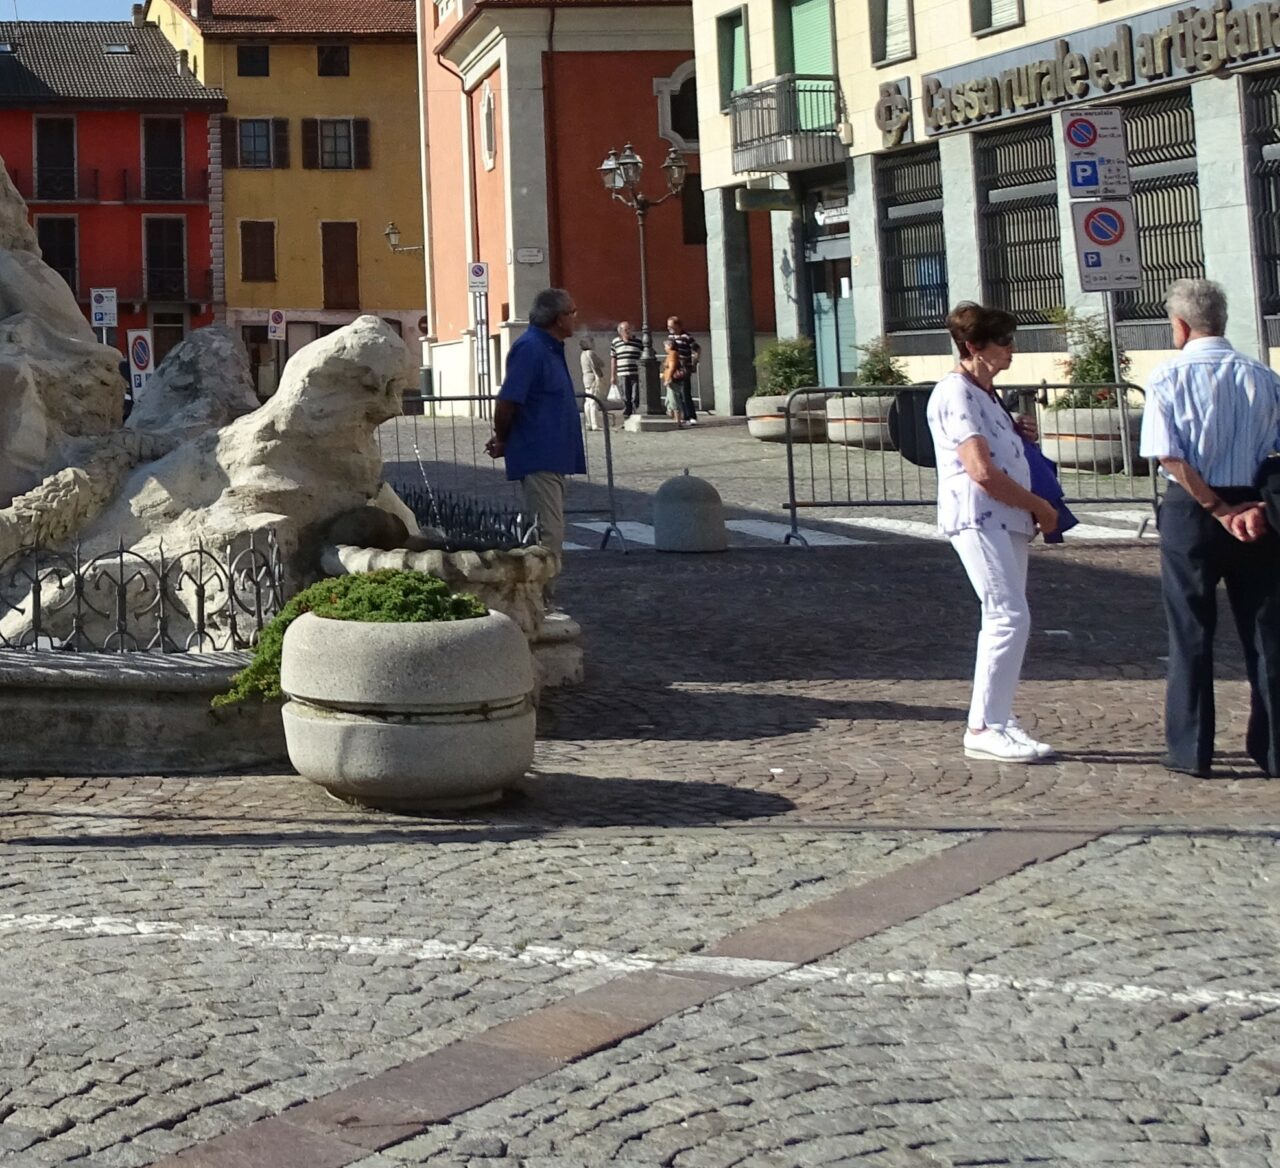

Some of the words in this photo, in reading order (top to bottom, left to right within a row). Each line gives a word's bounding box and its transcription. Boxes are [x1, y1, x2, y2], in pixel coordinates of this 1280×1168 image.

[923, 76, 1000, 130] Cassa
[1000, 38, 1089, 113] rurale
[1089, 24, 1134, 93] ed
[1076, 164, 1093, 183] P
[1087, 254, 1098, 266] P
